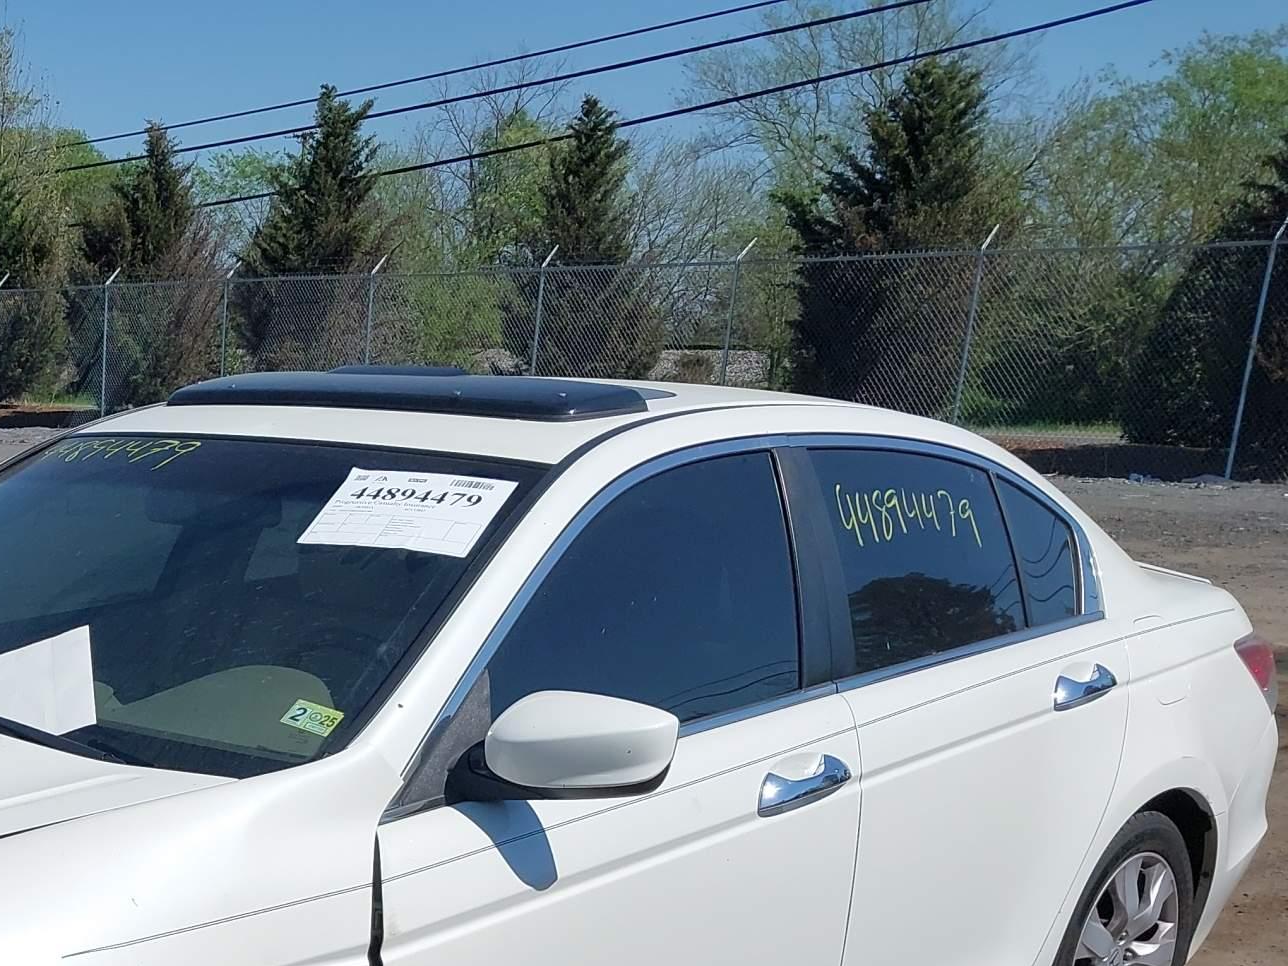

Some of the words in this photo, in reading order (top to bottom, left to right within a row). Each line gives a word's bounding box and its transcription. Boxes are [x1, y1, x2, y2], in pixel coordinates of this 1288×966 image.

[350, 486, 483, 508] 44894479
[836, 484, 983, 548] 44894479
[288, 707, 308, 722] 2
[319, 714, 338, 728] 25
